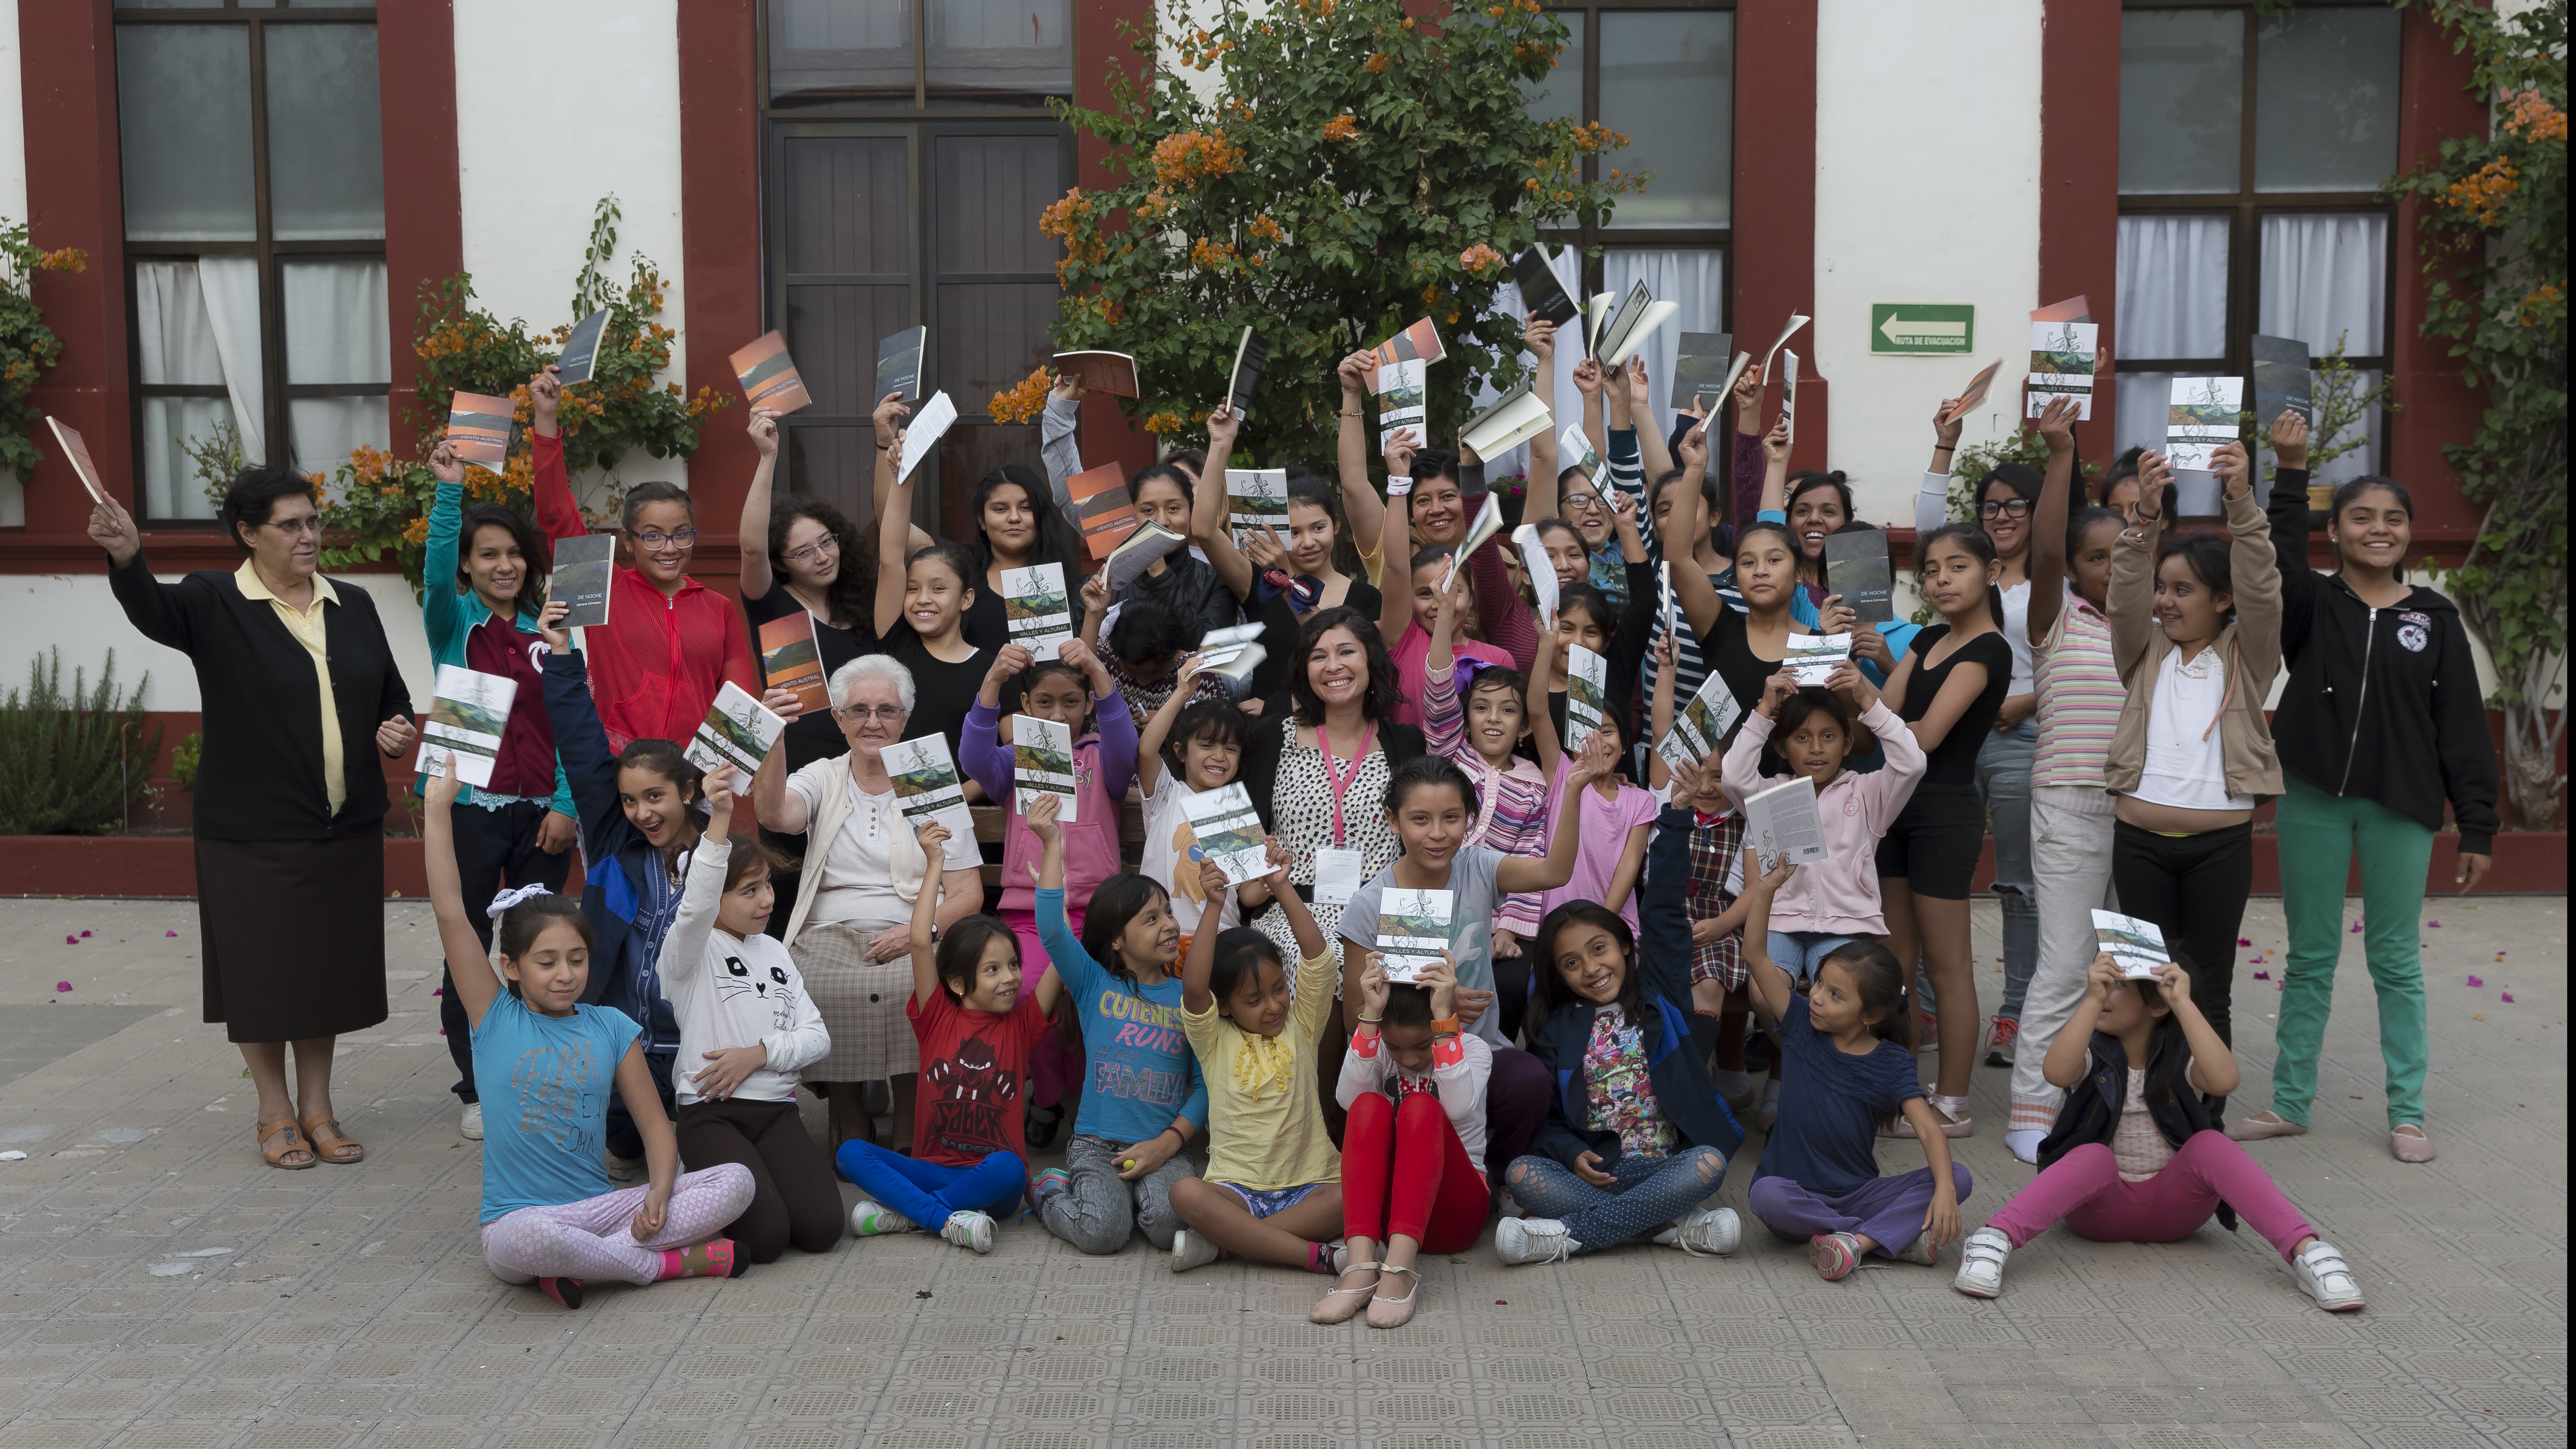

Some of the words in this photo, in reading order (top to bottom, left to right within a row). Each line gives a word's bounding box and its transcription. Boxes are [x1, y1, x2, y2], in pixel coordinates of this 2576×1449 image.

[1896, 337, 1913, 345] RUTA
[1914, 337, 1923, 345] DE
[1096, 523, 1113, 532] VIENTO
[1113, 516, 1135, 526] AUSTRAL
[779, 680, 797, 688] VIENTO
[798, 674, 821, 684] AUSTRAL
[1576, 715, 1588, 723] VALLES
[1679, 731, 1690, 746] VALLES
[706, 739, 724, 755] VALLES
[729, 756, 752, 774] ALTURAS
[936, 797, 961, 808] ALTURAS
[1114, 1023, 1188, 1055] RUNS
[1113, 1049, 1142, 1062] MY
